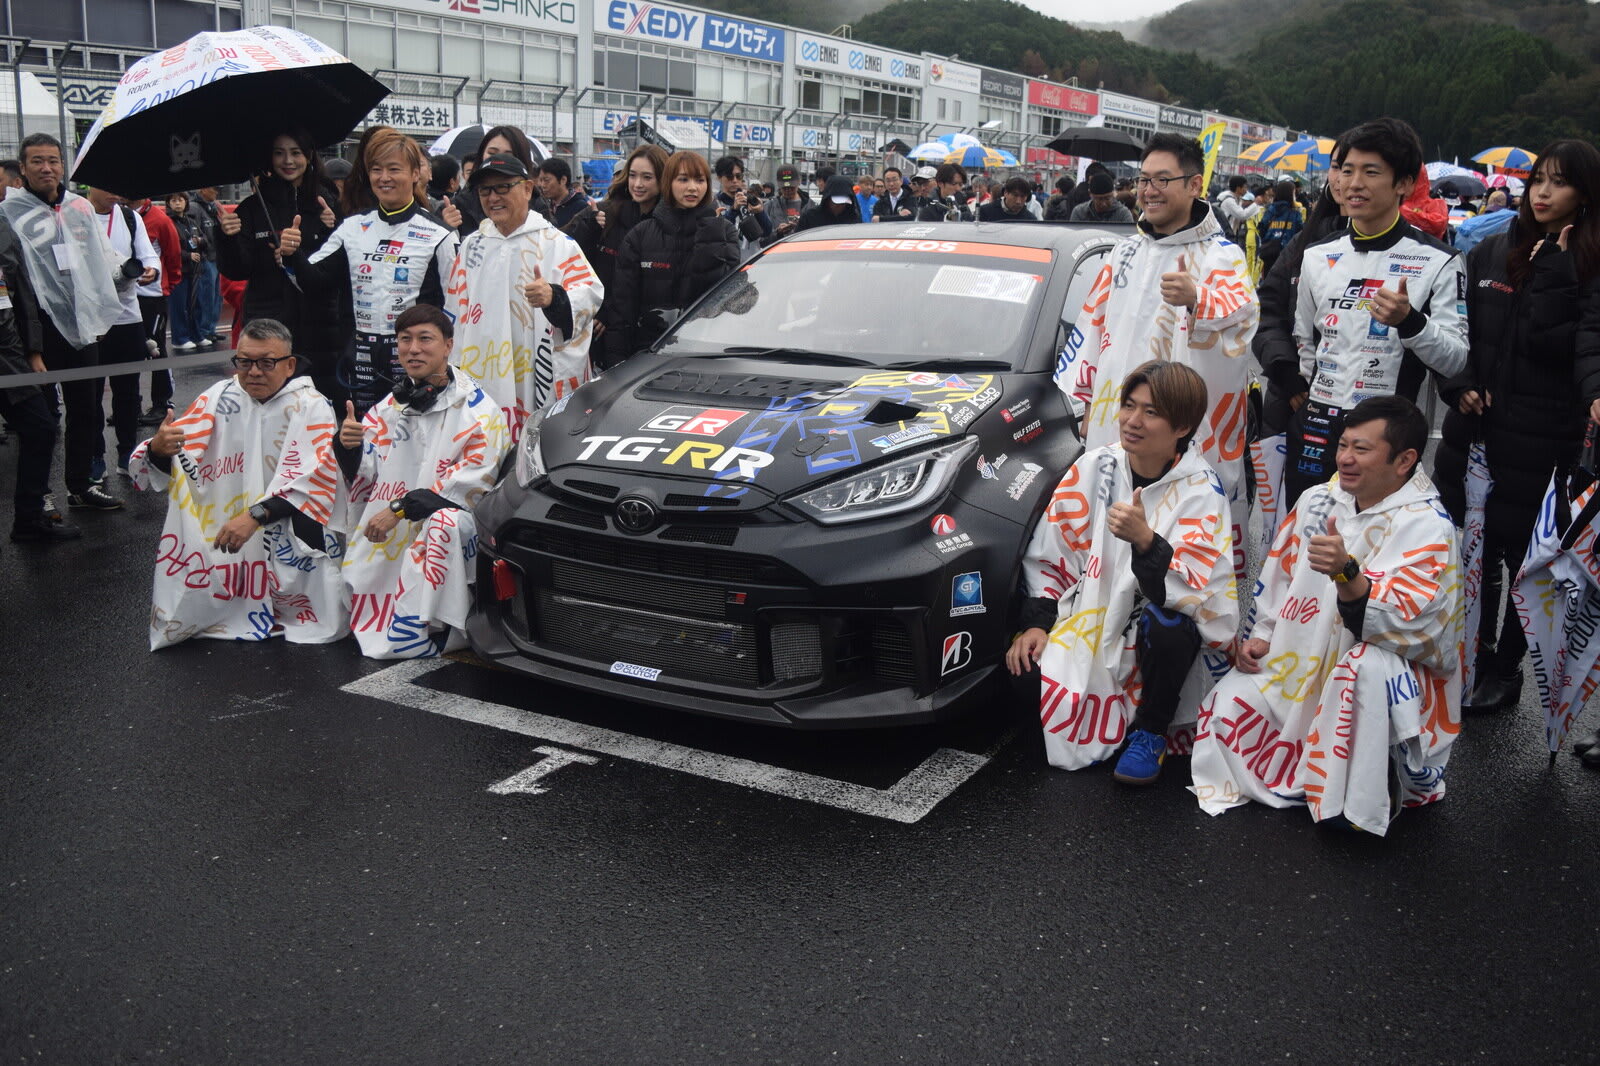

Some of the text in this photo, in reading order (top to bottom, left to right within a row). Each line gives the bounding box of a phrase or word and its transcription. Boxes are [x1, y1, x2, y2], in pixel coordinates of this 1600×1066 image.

[607, 0, 698, 42] EXEDY
[709, 19, 776, 56] エクセディ
[819, 45, 921, 80] ENKEI ENKEI ENKEI
[982, 80, 1021, 97] RECARO RECARO
[733, 124, 774, 142] EXEDY
[376, 244, 402, 255] GR
[856, 239, 958, 252] ENEOS
[978, 390, 1001, 410] GROUP
[951, 406, 970, 423] GRUPO
[957, 411, 976, 428] PURDY
[647, 414, 729, 434] GR
[576, 435, 775, 479] TG-RR
[622, 667, 656, 679] CLUTCH
